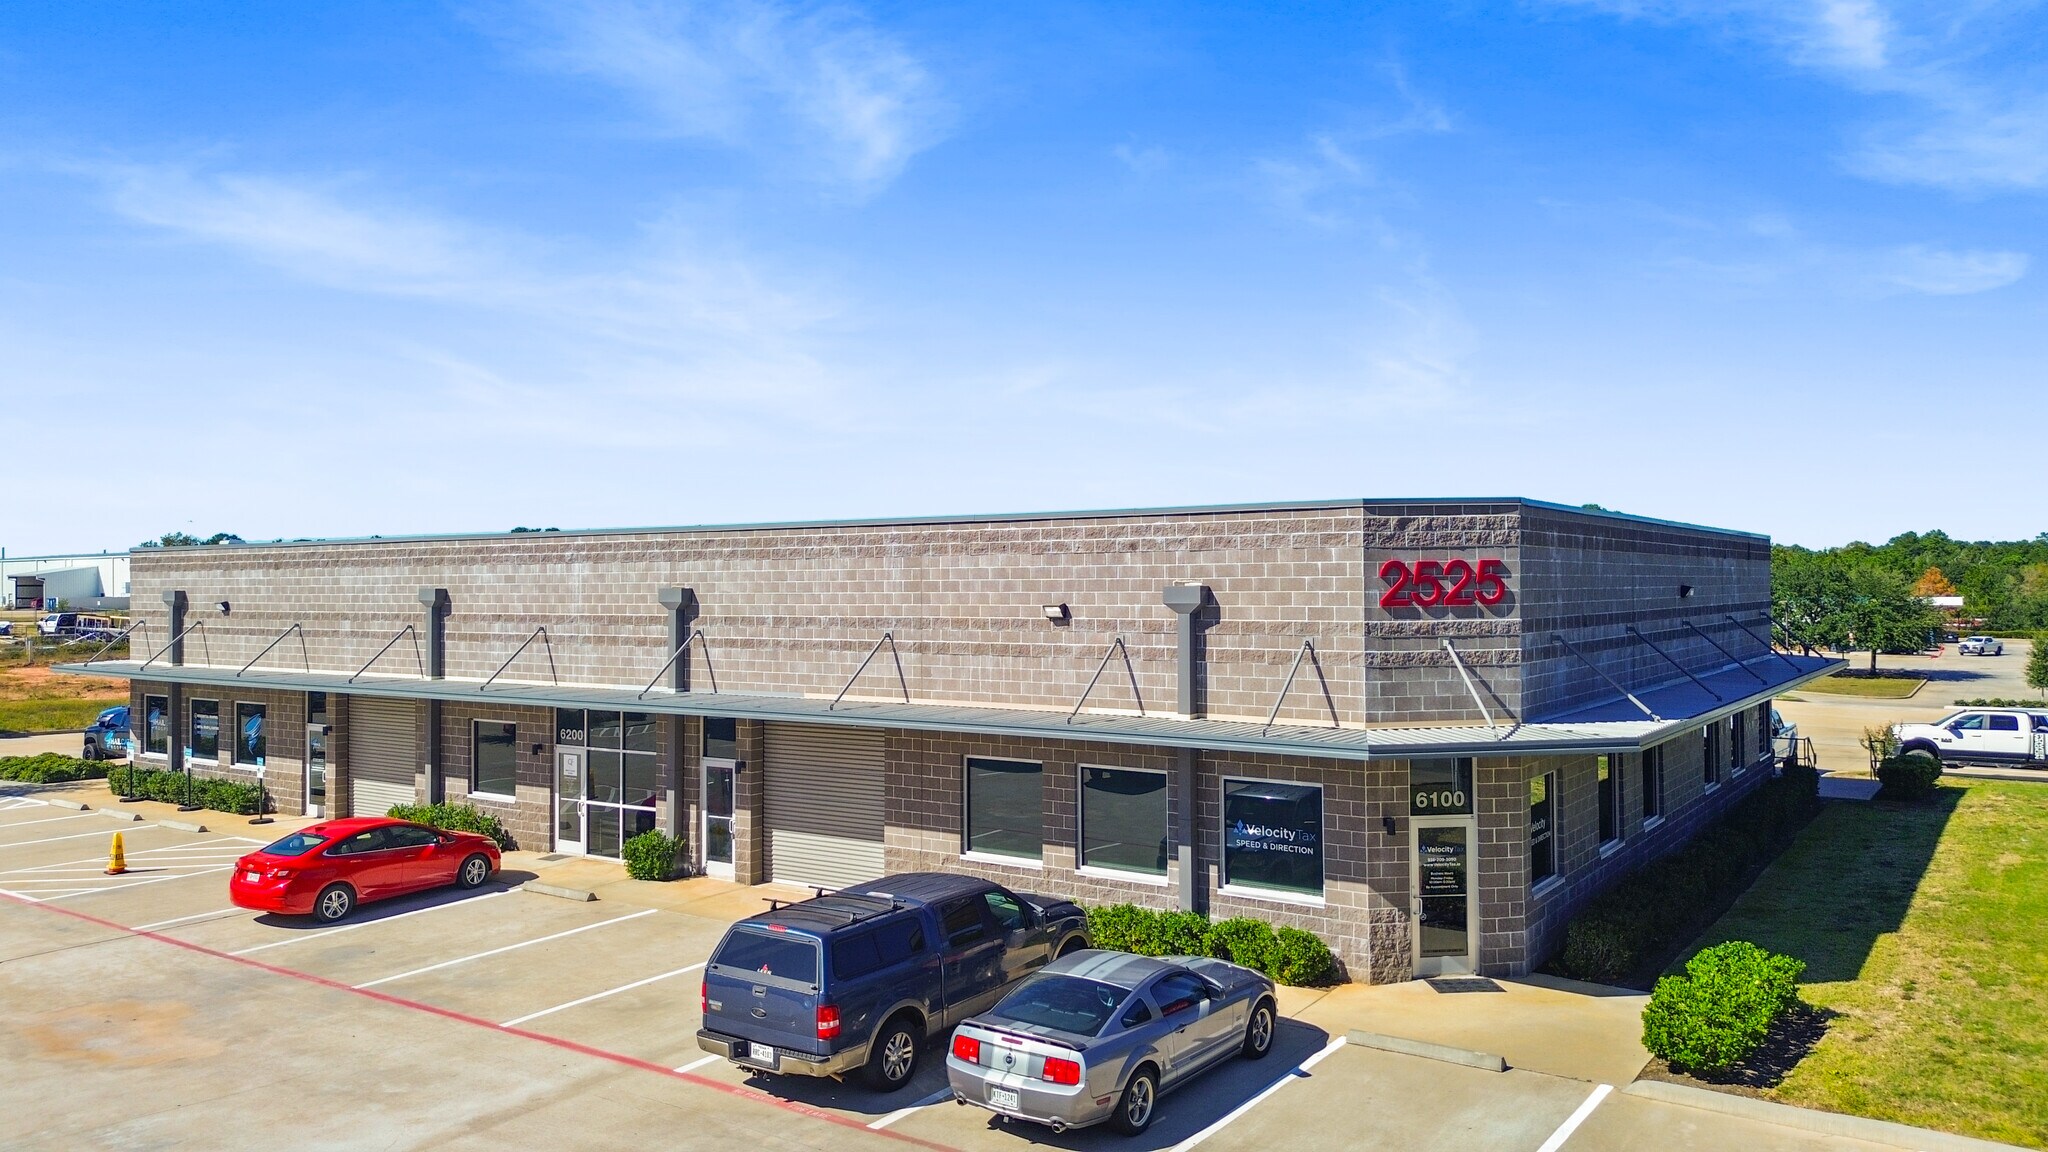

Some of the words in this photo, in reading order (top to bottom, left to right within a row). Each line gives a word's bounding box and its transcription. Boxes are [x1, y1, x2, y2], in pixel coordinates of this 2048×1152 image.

[1379, 559, 1506, 607] 2525
[560, 728, 583, 741] 6200
[1415, 790, 1465, 808] 6100
[1236, 839, 1261, 849] SPEED
[1262, 842, 1269, 850] &
[1269, 843, 1314, 855] DIRECTION
